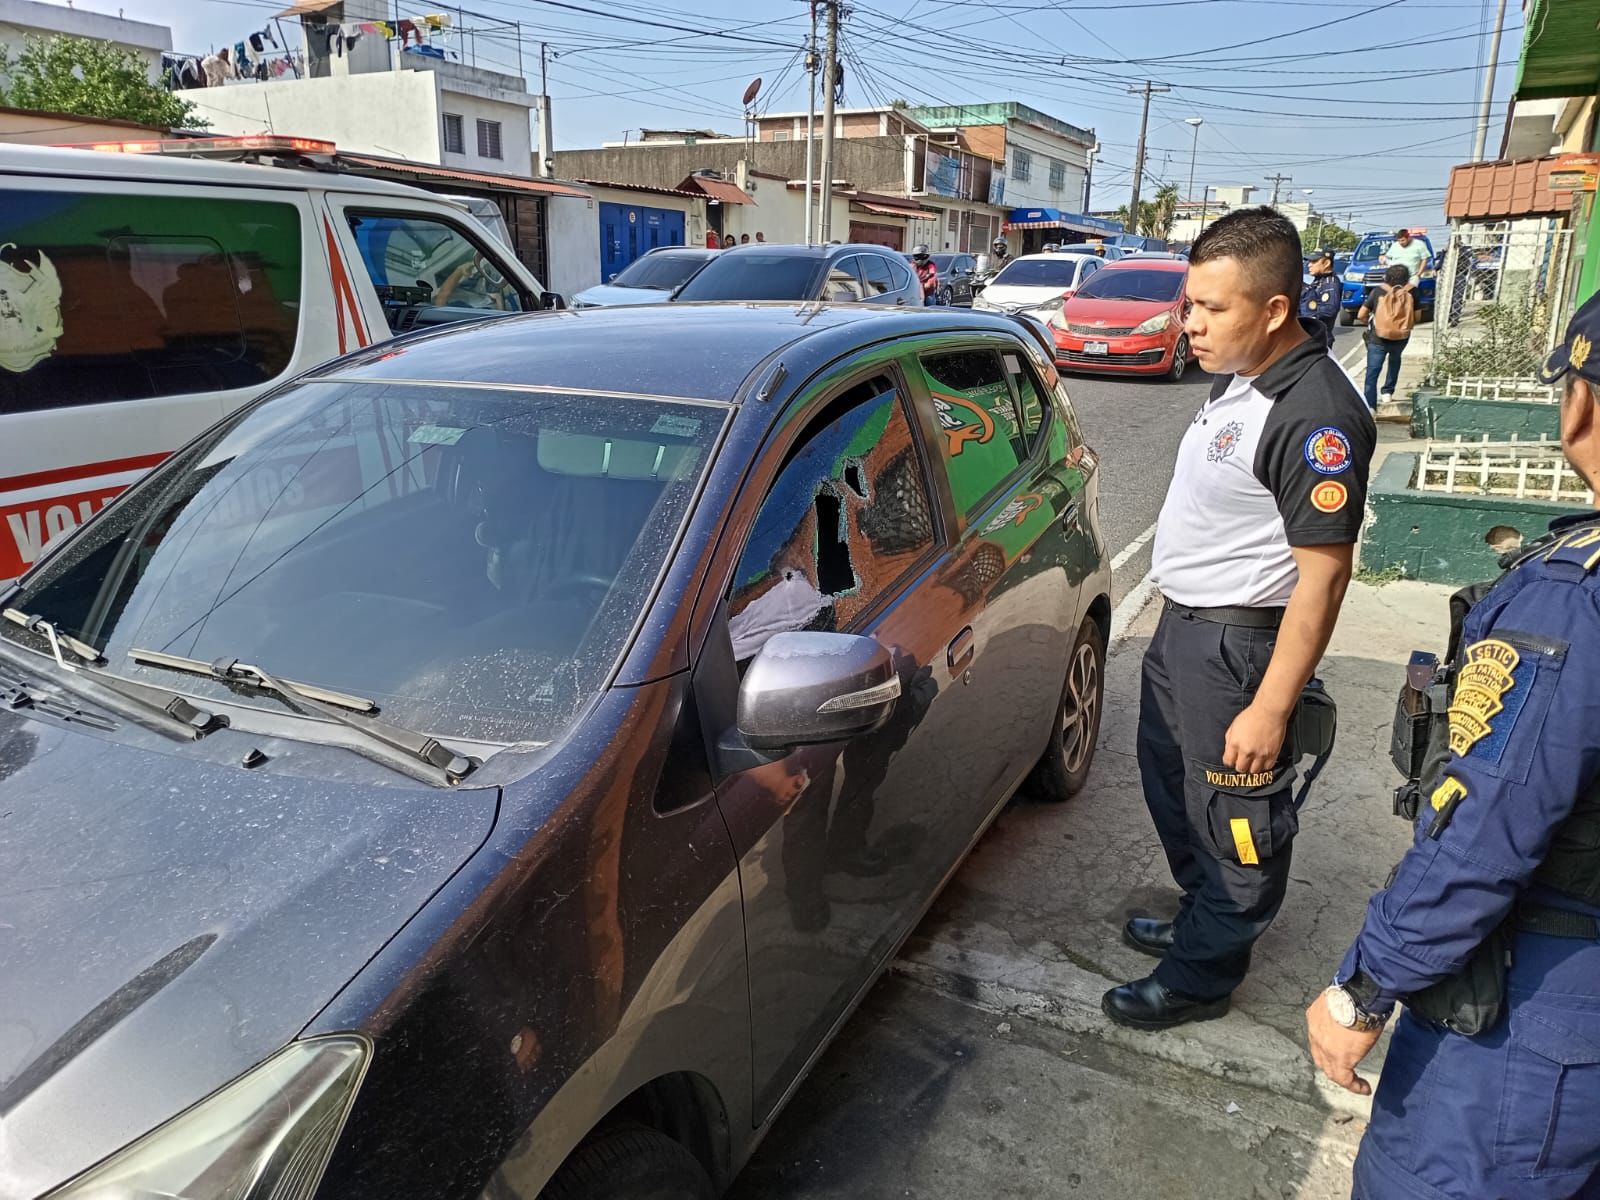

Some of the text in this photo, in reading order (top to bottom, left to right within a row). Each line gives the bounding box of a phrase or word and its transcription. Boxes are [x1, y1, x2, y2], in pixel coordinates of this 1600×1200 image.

[1315, 460, 1349, 472] GUATEMALA
[1476, 646, 1512, 664] SGTIC
[1476, 665, 1505, 685] PATROL
[1205, 770, 1273, 787] VOLUNTARIOS
